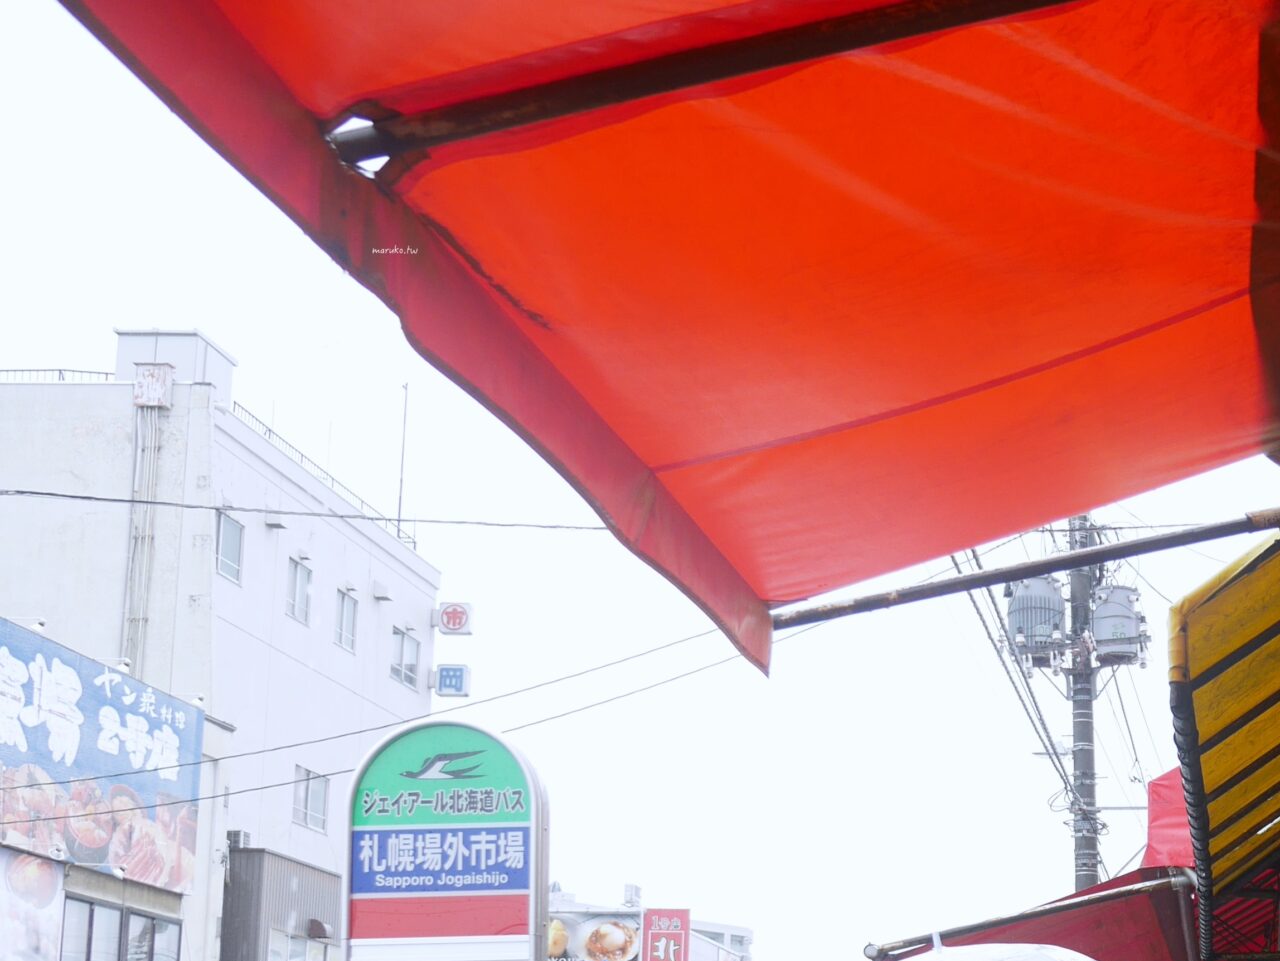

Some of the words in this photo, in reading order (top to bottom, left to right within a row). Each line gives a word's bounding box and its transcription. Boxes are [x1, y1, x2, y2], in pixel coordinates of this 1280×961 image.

[360, 831, 525, 873] 札幌場外市場
[375, 874, 434, 888] Sapporo
[437, 872, 509, 887] Jogaishijo
